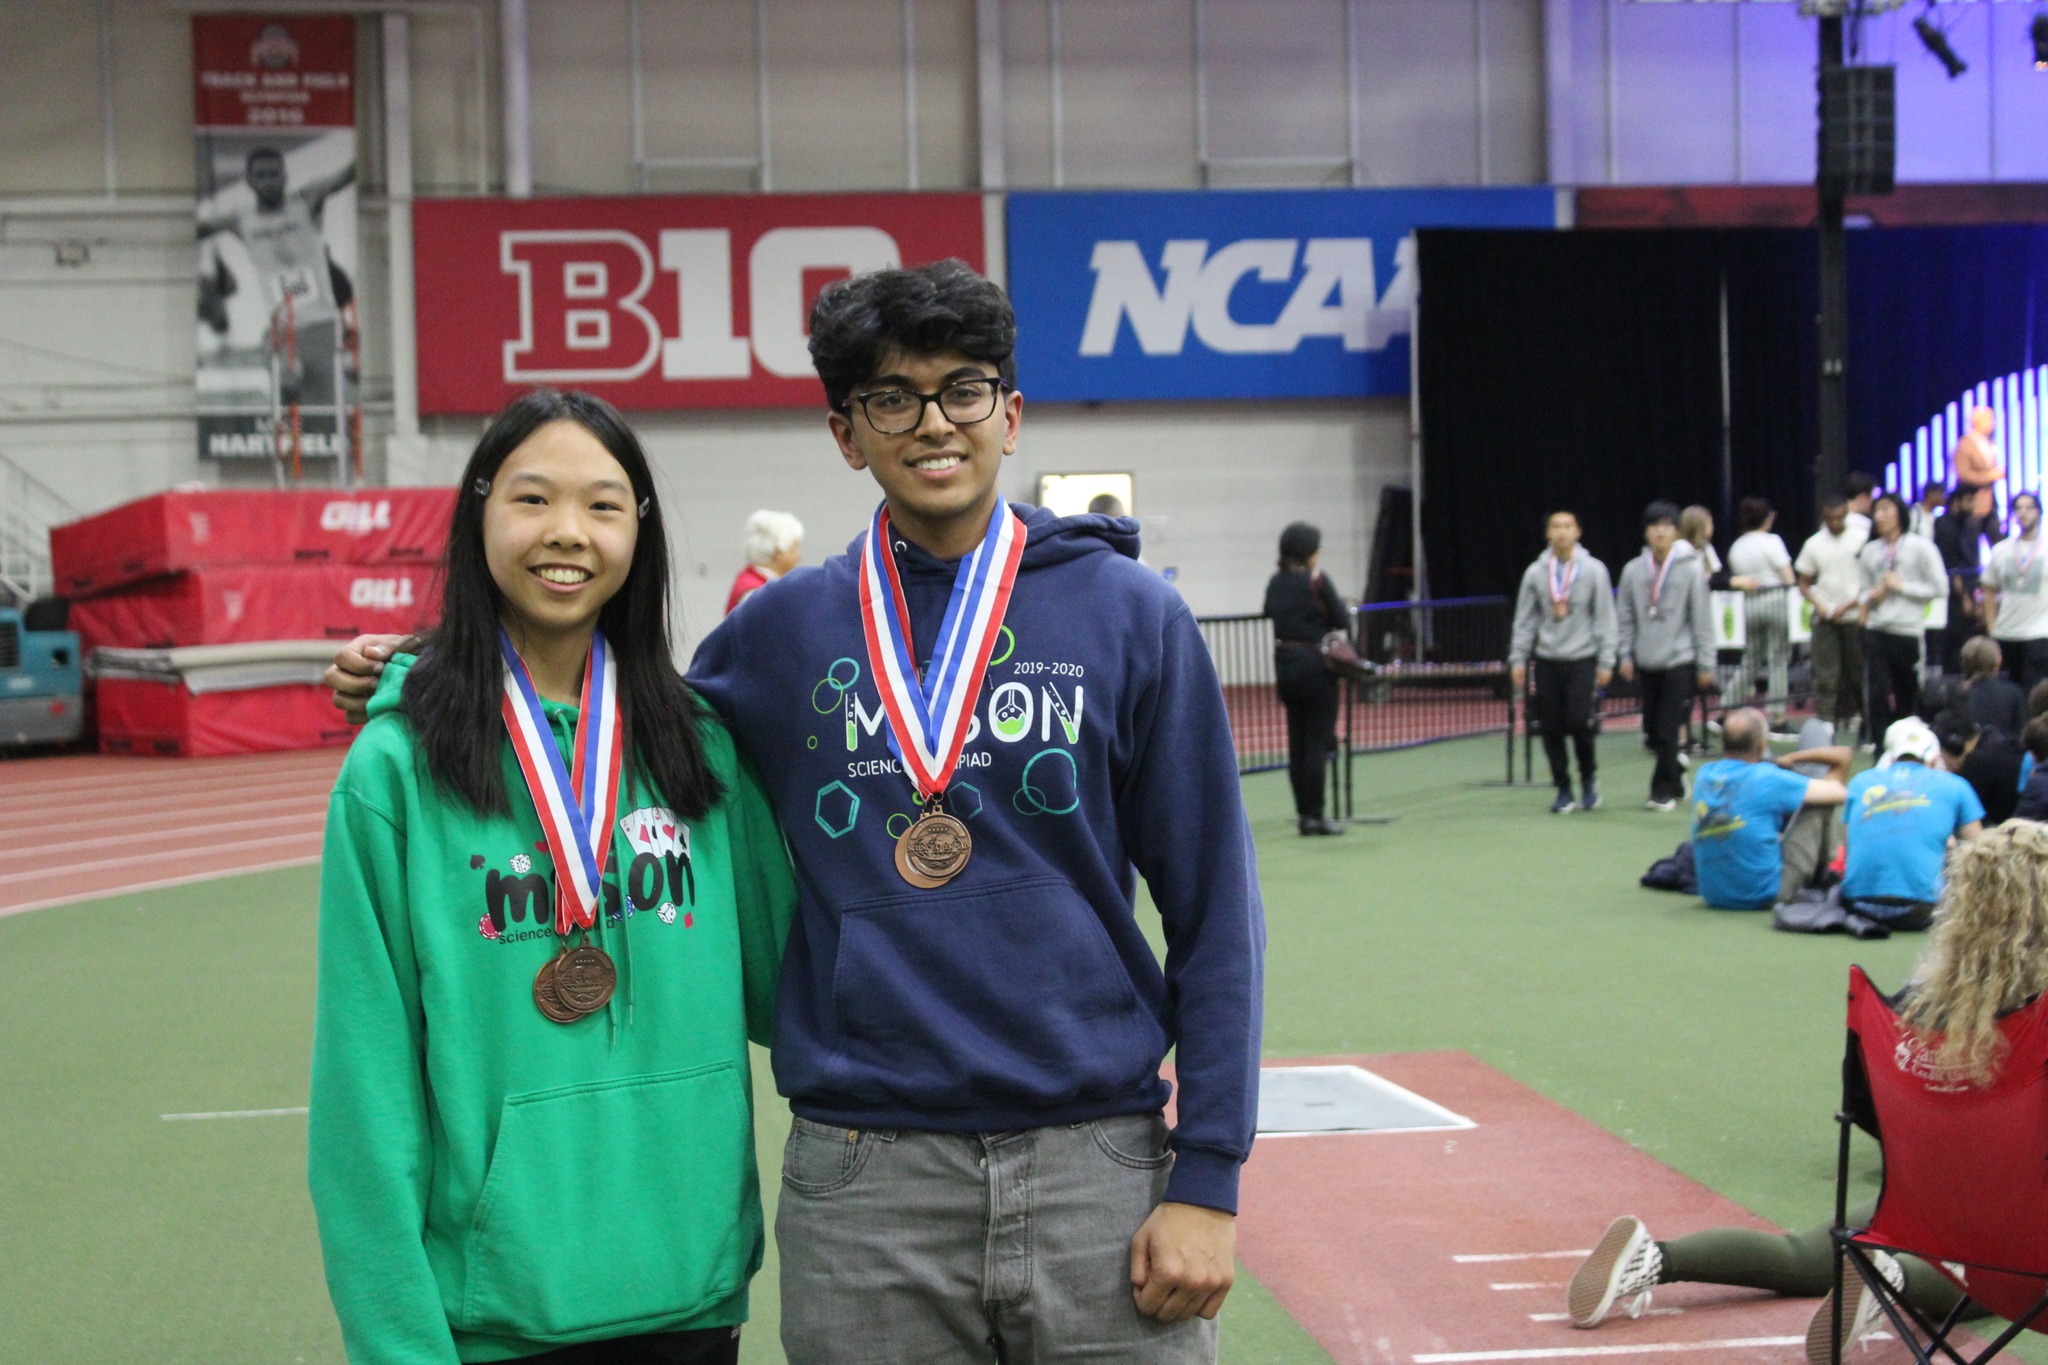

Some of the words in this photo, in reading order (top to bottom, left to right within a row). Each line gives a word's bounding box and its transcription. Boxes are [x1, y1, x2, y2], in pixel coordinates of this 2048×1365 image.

[1013, 661, 1084, 678] 2019-2020
[848, 758, 905, 778] SCIENC
[498, 926, 552, 945] science
